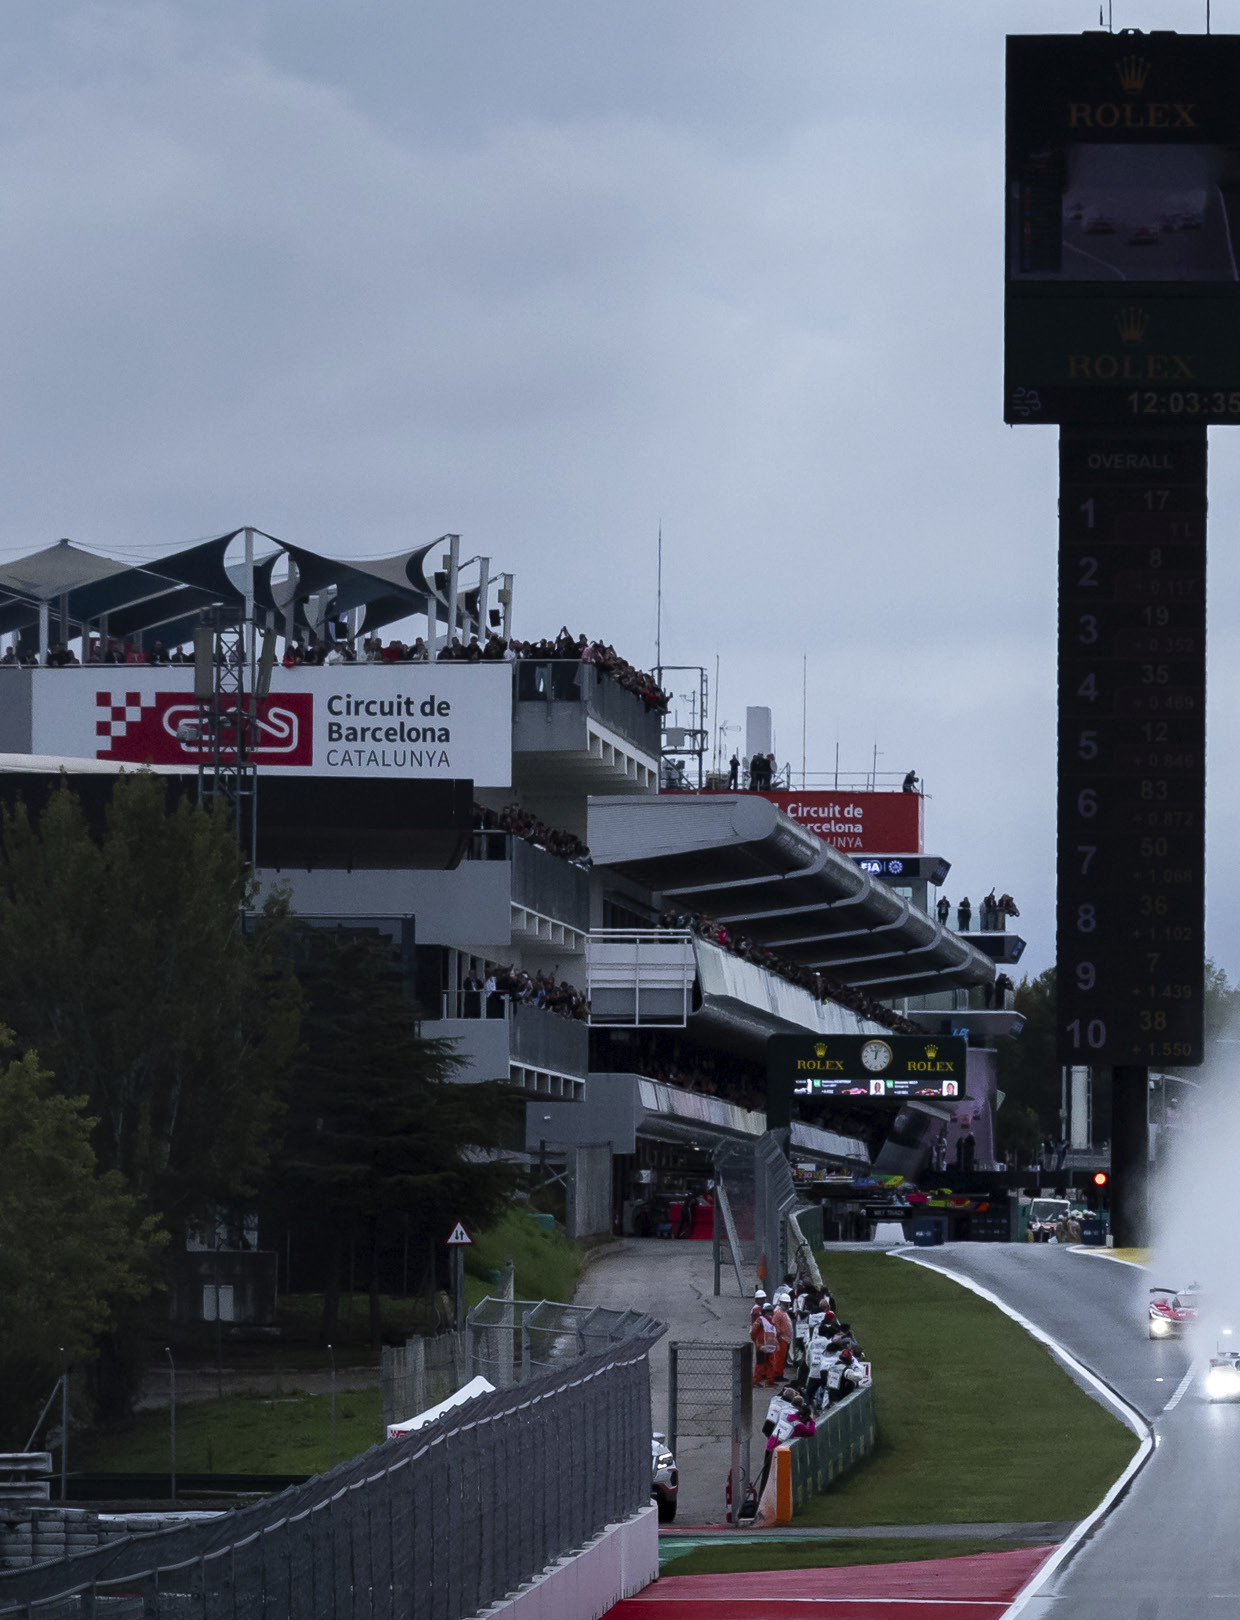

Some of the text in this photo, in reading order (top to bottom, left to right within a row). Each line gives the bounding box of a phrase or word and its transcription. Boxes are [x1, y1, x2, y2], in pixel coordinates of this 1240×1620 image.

[1070, 104, 1195, 127] ROLEX
[1070, 355, 1194, 378] ROLEX
[1088, 454, 1172, 468] OVERALL
[1144, 490, 1169, 509] 17
[1081, 498, 1094, 528] 1
[1150, 548, 1162, 568] 8
[1079, 557, 1098, 586] 2
[1144, 606, 1168, 625] 19
[1080, 615, 1098, 644] 3
[1142, 665, 1168, 684] 35
[1078, 673, 1098, 701] 4
[328, 694, 450, 717] Circuit de
[328, 722, 449, 742] Barcelona
[1143, 722, 1167, 741] 12
[1079, 731, 1098, 760] 5
[327, 749, 450, 767] CATALUNYA
[1141, 780, 1168, 799] 83
[787, 803, 863, 818] Circuit de
[1078, 789, 1097, 817] 6
[804, 820, 863, 833] rcelona
[1142, 837, 1167, 856] 50
[860, 862, 880, 873] FIA
[1077, 846, 1096, 874] 7
[1141, 895, 1167, 915] 36
[1077, 904, 1096, 932] 8
[1147, 953, 1160, 972] 7
[1077, 962, 1096, 990] 9
[1140, 1011, 1166, 1030] 38
[1067, 1019, 1106, 1048] 10
[798, 1060, 843, 1070] ROLEX
[908, 1062, 953, 1071] ROLEX
